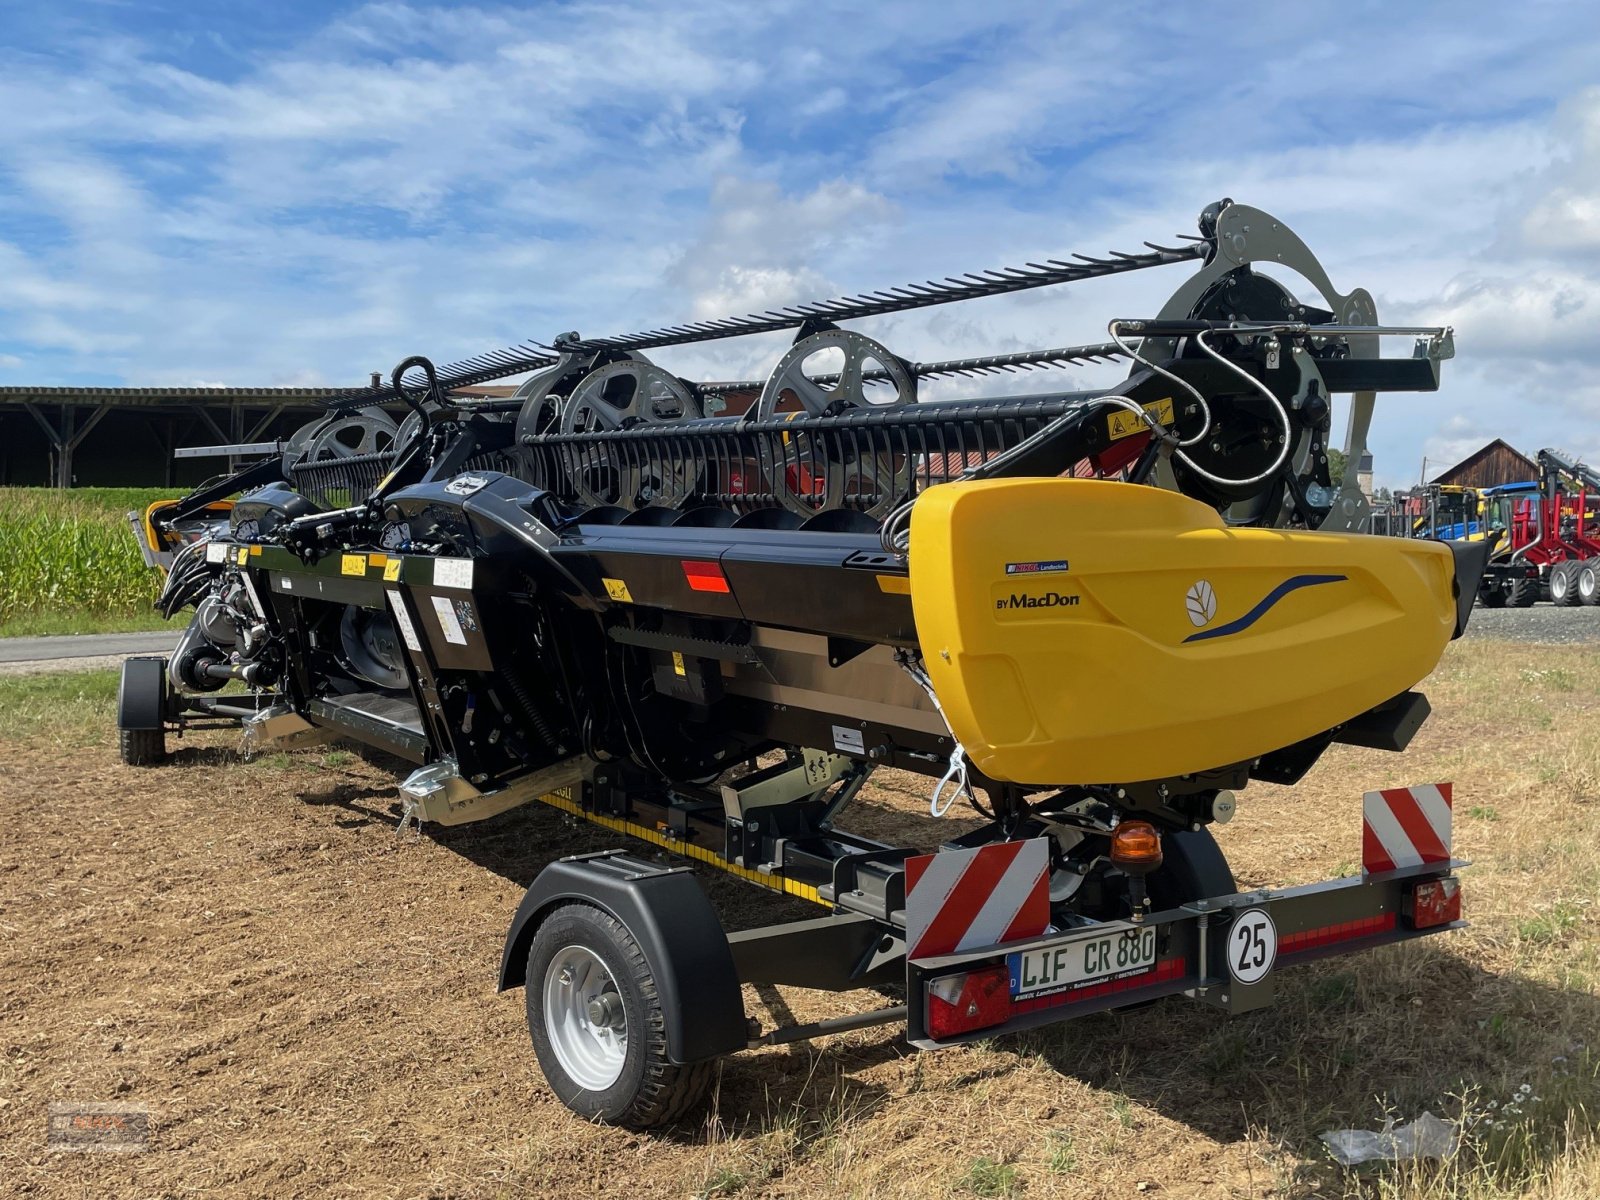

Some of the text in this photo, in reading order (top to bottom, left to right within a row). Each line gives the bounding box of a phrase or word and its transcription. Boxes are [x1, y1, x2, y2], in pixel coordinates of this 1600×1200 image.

[996, 592, 1080, 609] BY MacDon
[1022, 930, 1154, 988] LIF CR 880
[1237, 921, 1267, 971] 25
[1010, 978, 1017, 988] D
